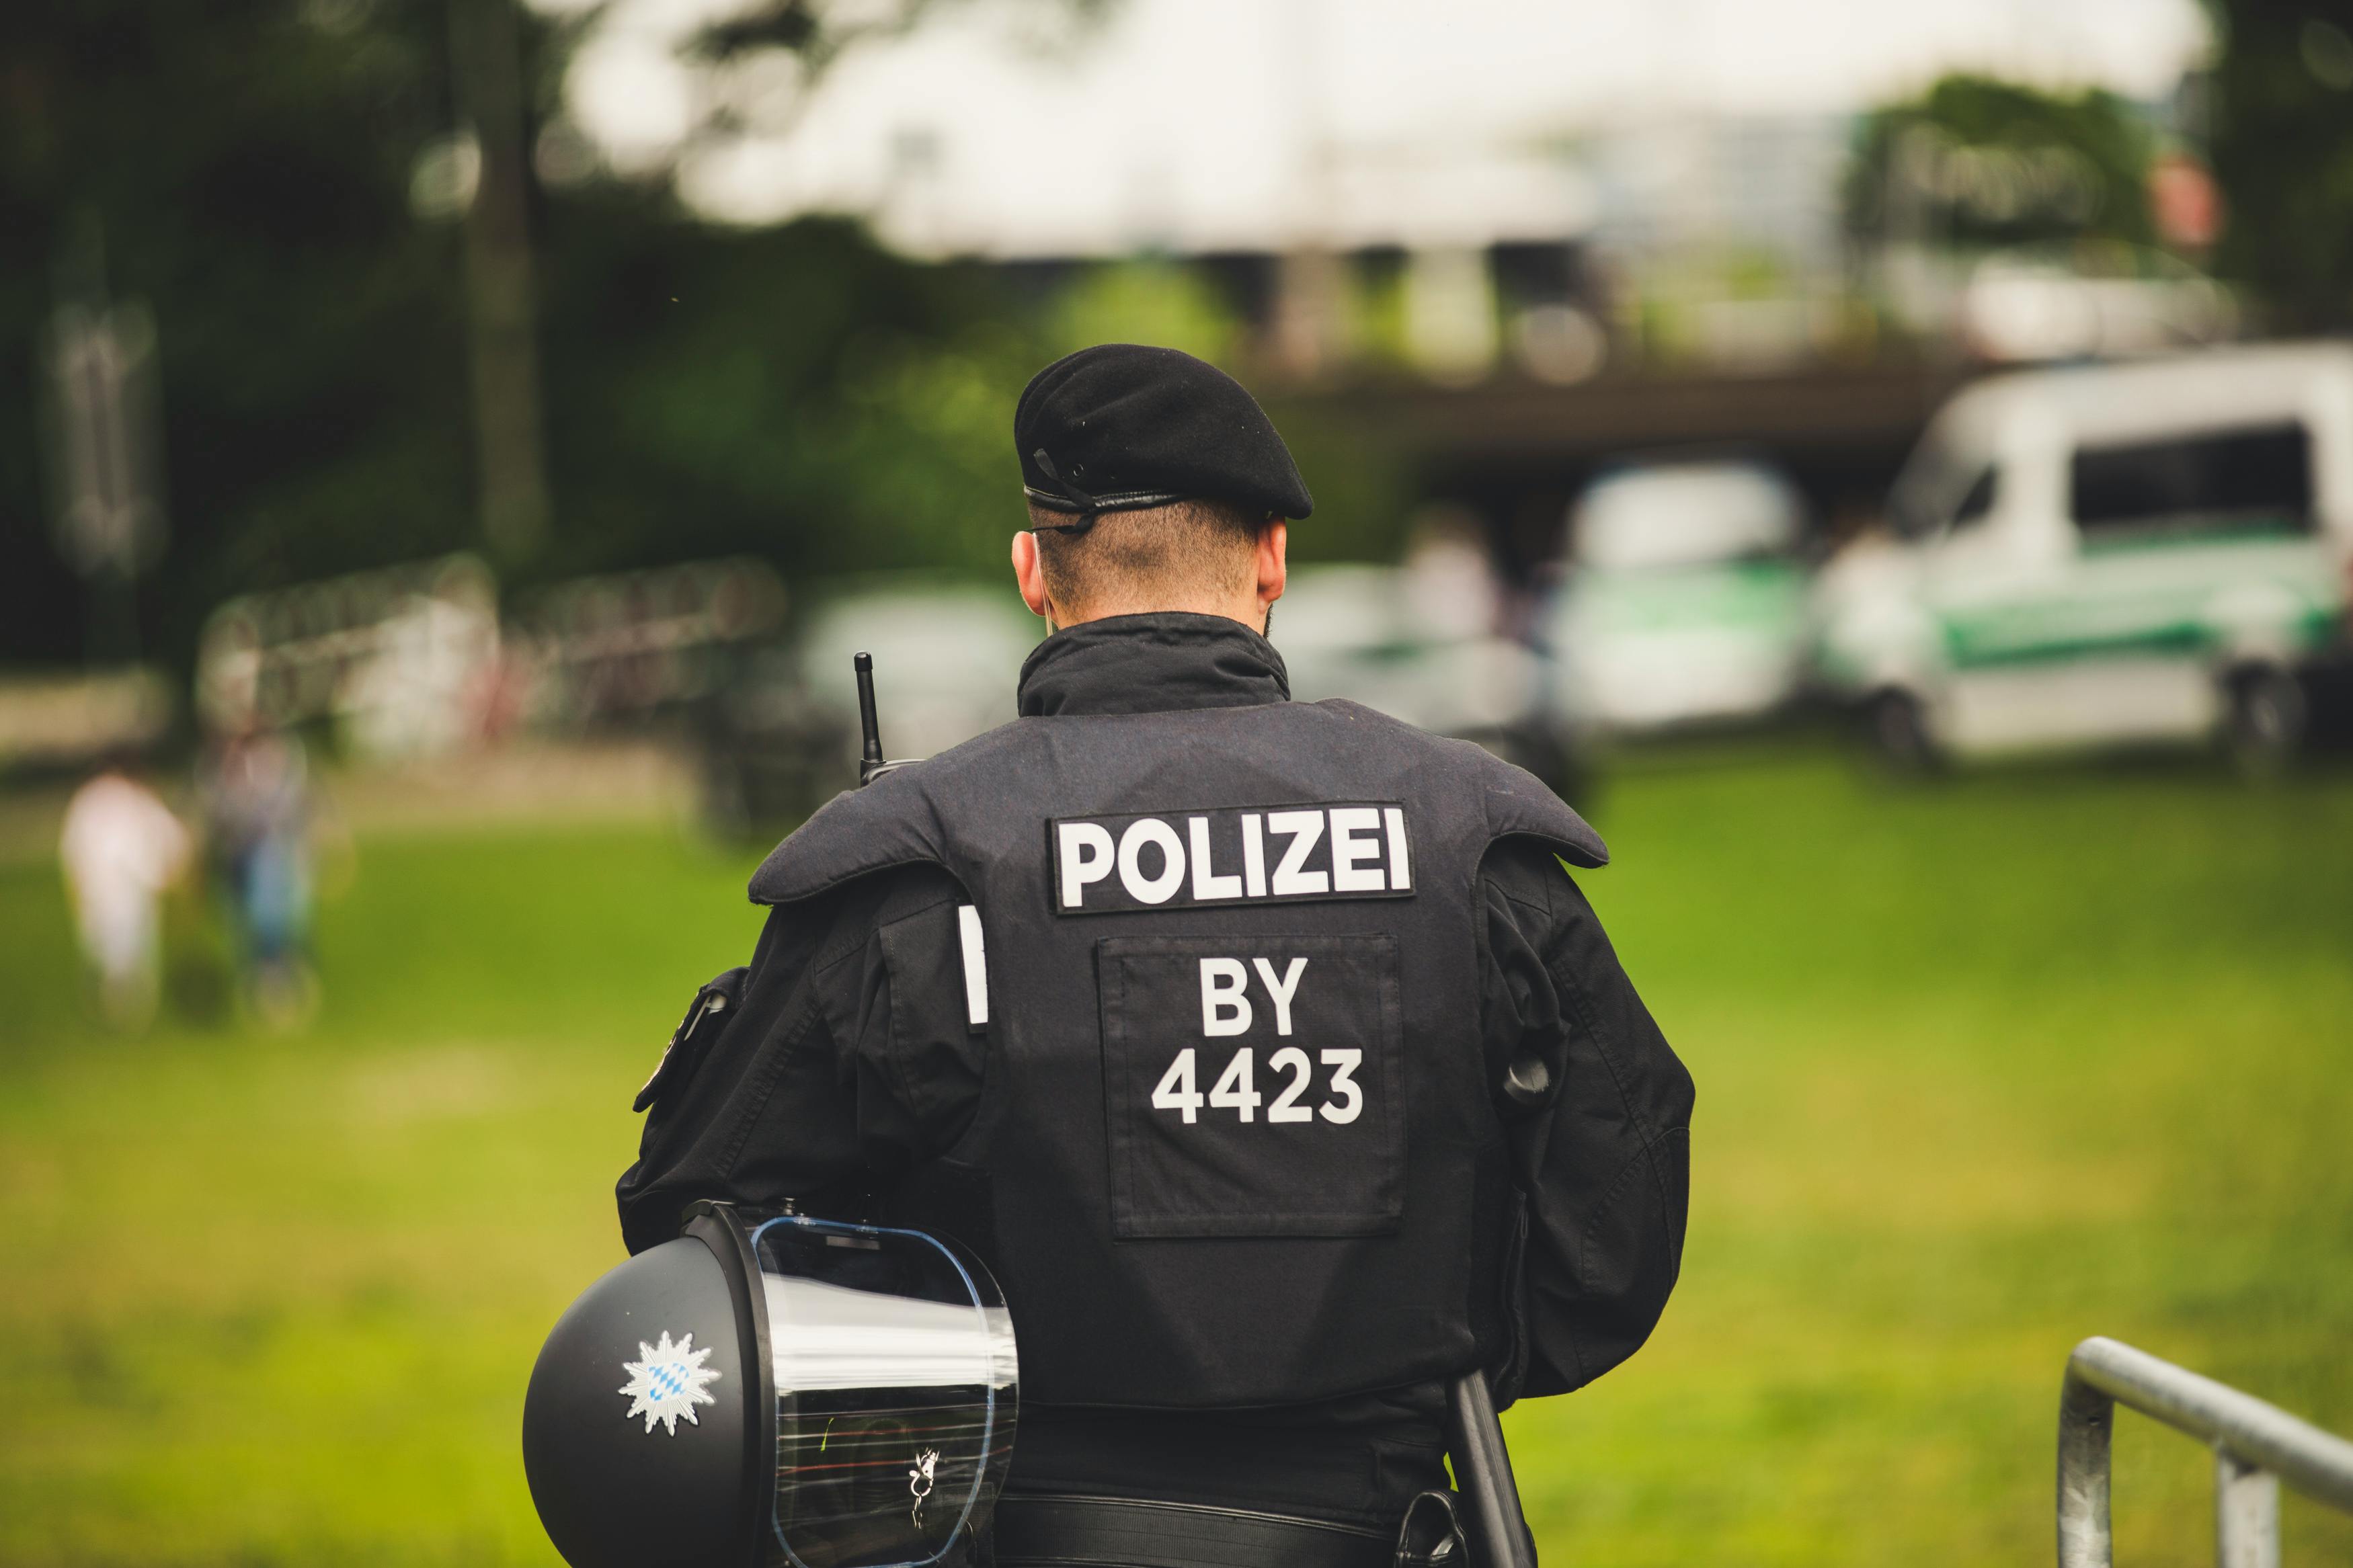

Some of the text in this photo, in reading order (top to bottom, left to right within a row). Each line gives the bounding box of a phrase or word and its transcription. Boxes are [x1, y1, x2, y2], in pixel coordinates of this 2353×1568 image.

[1058, 807, 1411, 907] POLIZEI
[1199, 957, 1308, 1037] BY
[1151, 1046, 1363, 1124] 4423
